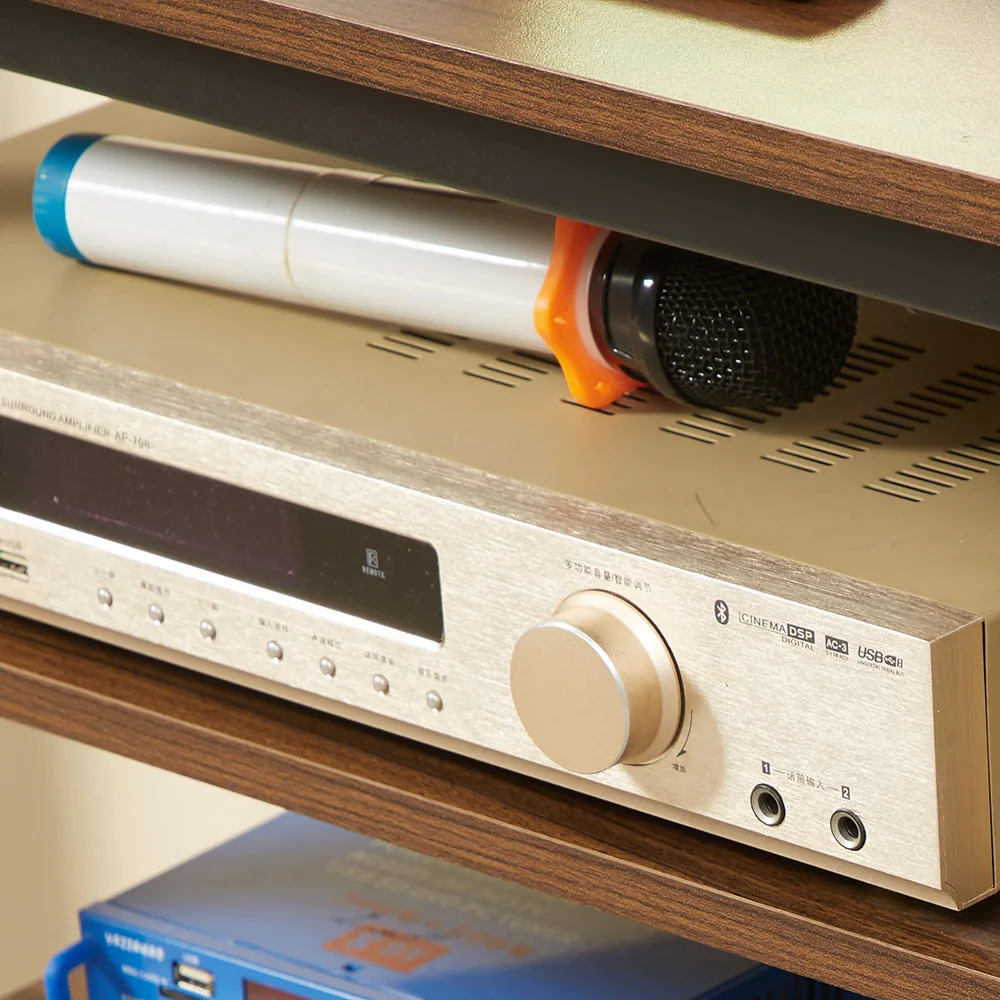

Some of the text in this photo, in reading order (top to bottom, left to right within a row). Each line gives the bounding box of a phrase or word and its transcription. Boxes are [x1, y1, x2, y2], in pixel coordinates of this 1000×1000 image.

[0, 396, 56, 421] SURROUND
[57, 414, 111, 437] AMPLIFIER
[740, 612, 815, 643] CINEMA DSP
[781, 636, 815, 652] DIGITAL
[825, 637, 849, 654] AC-3
[857, 645, 884, 664] USB
[762, 761, 851, 800] 1 话筒输入 2
